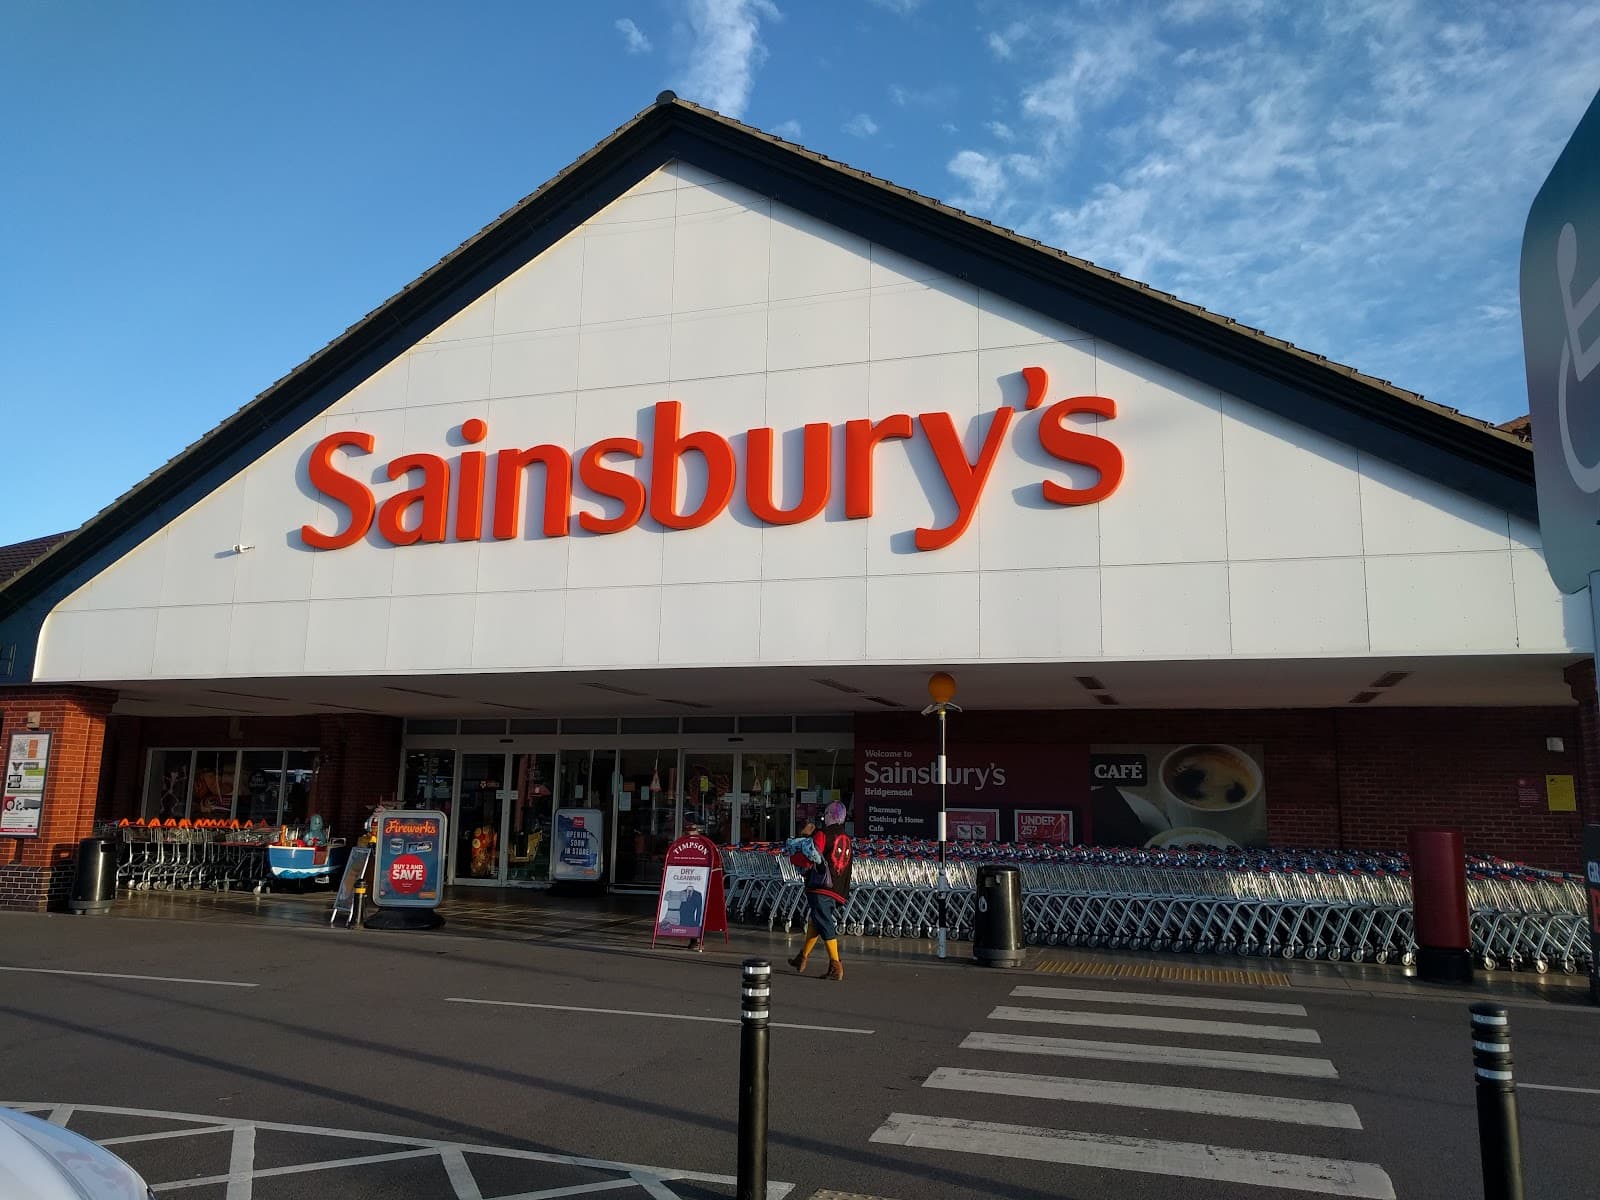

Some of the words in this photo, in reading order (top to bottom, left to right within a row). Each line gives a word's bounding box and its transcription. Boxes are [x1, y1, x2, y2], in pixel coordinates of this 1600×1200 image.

[301, 366, 1124, 552] Sainsbury's
[865, 749, 900, 758] Welcome
[903, 750, 912, 758] to
[1094, 761, 1143, 778] CAFÉ
[864, 761, 1006, 791] Sainsbury's
[864, 787, 913, 797] Bridgemead
[868, 806, 902, 815] Pharmacy
[868, 816, 897, 824] Clothing
[1020, 815, 1055, 826] UNDER
[385, 818, 436, 834] Fireworks
[1020, 825, 1037, 835] 25?
[673, 841, 709, 855] TIMPSON
[392, 869, 423, 880] SAVE
